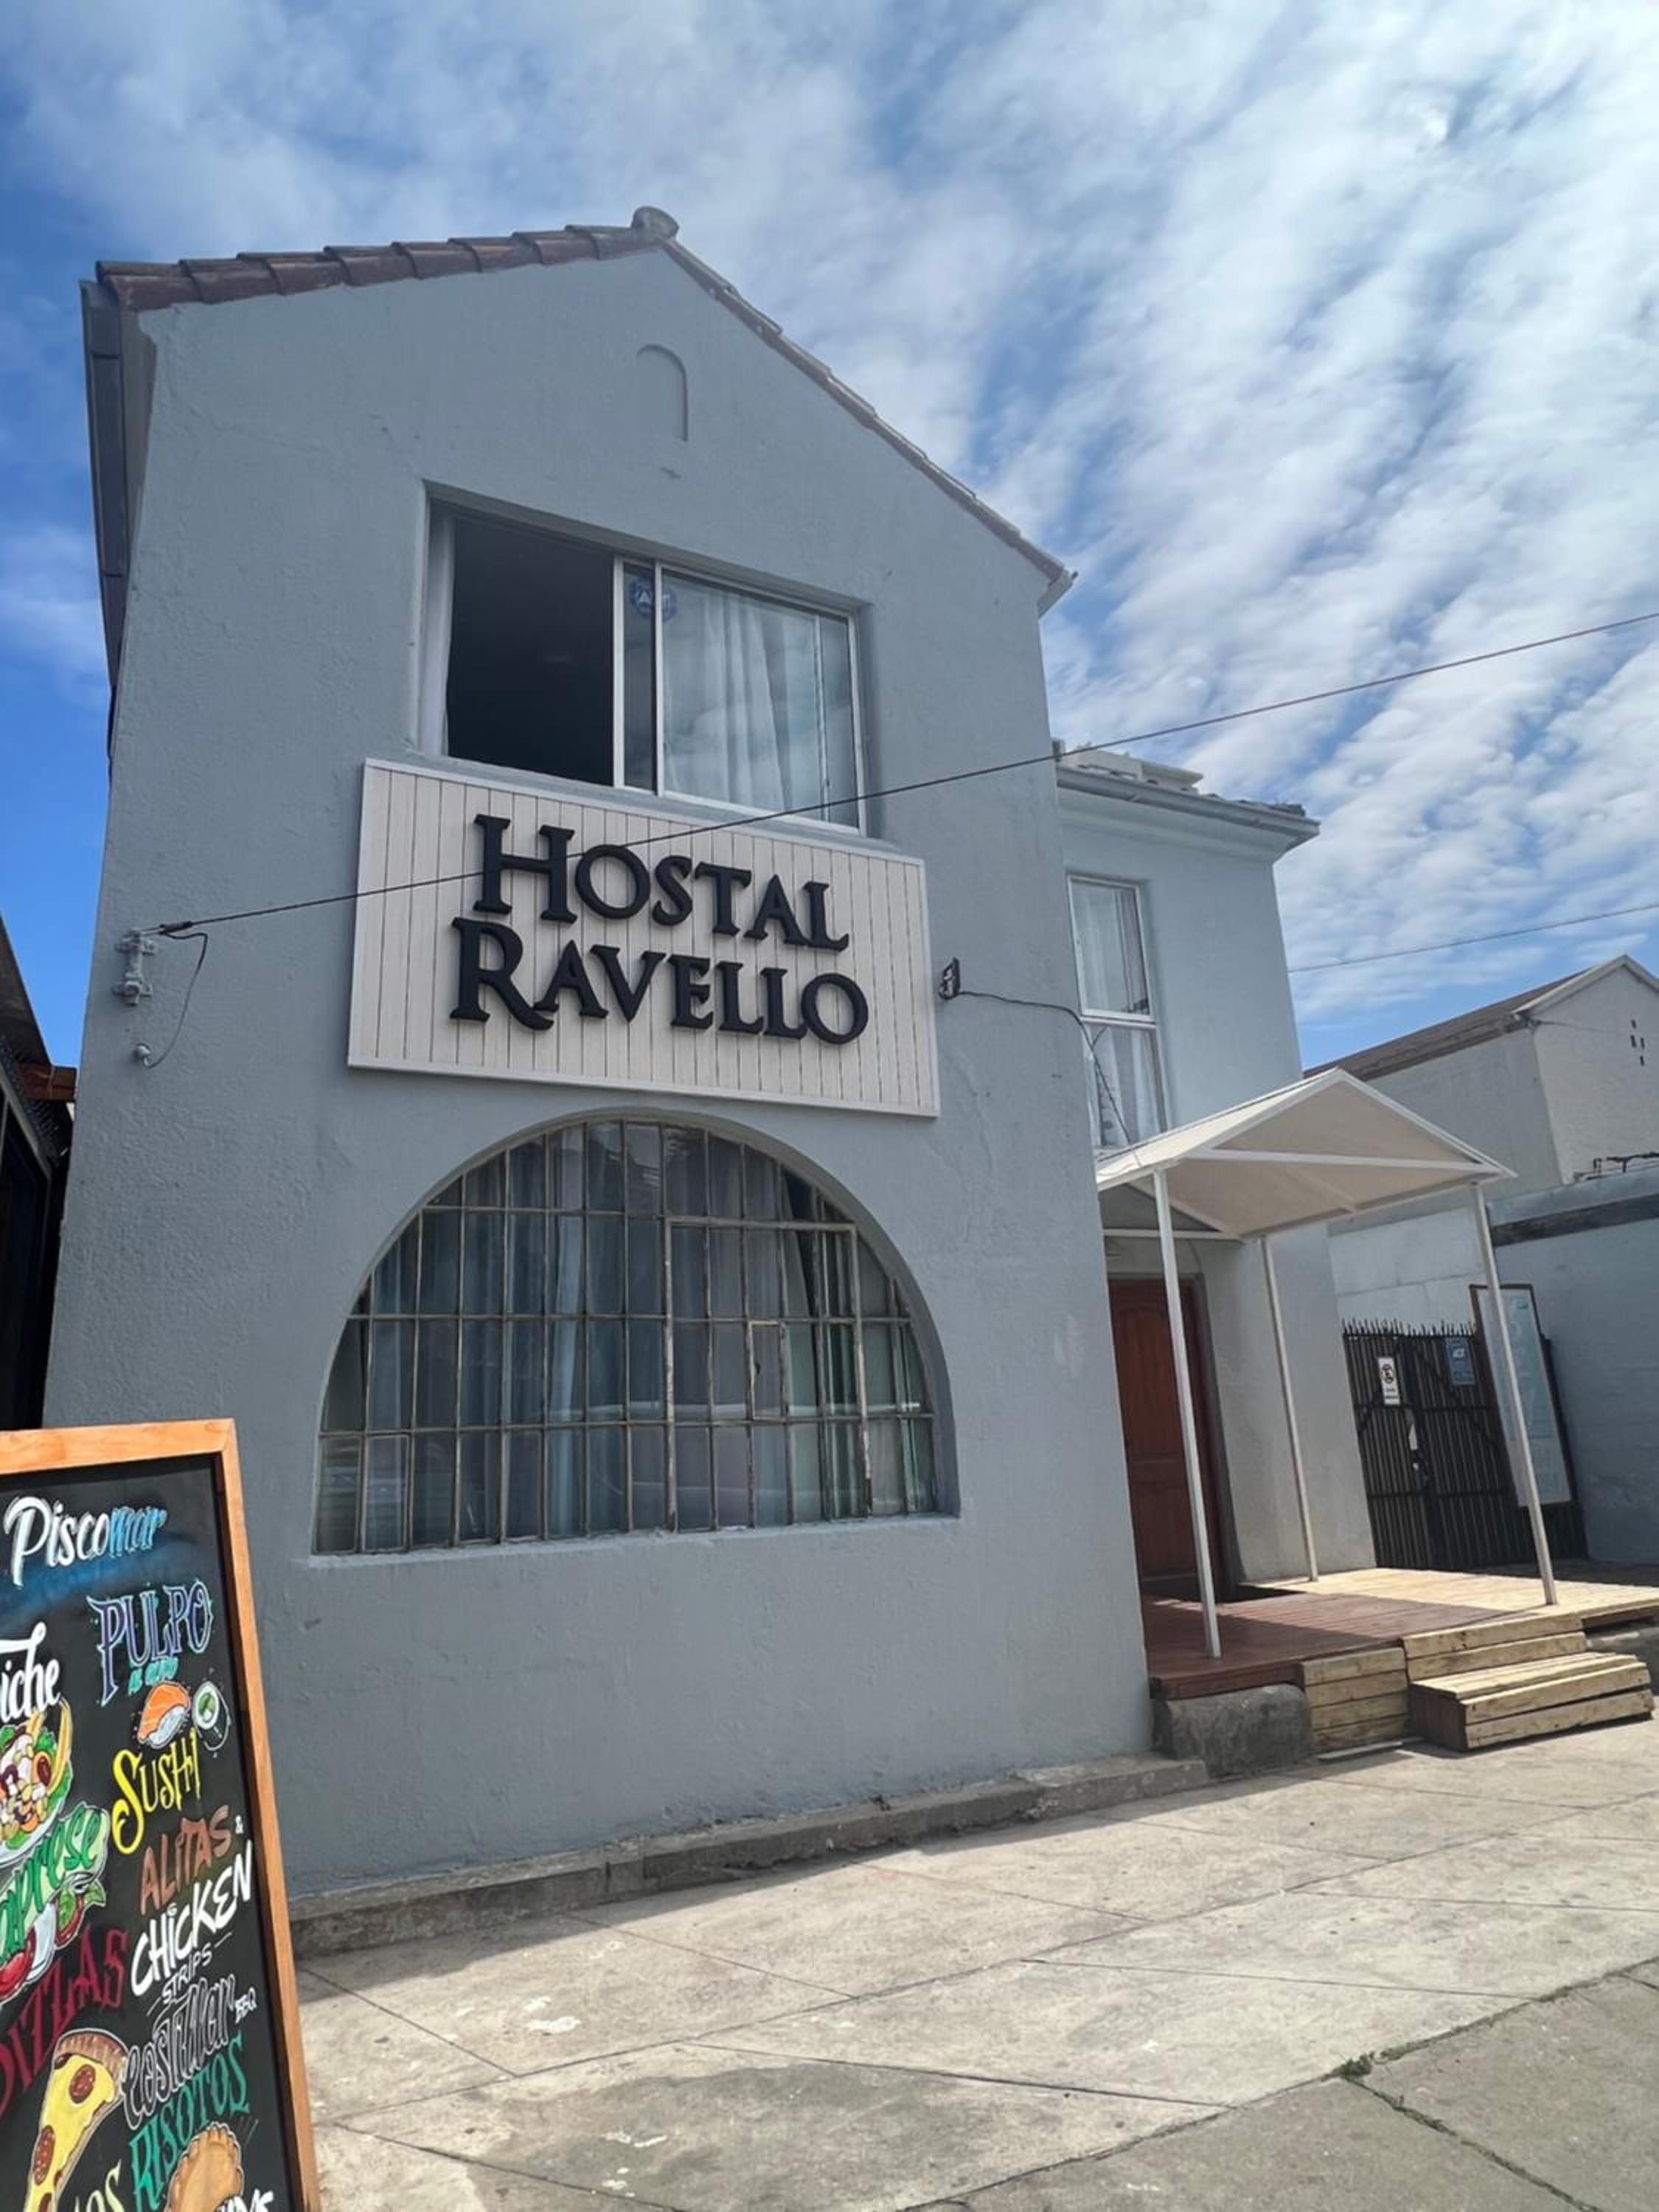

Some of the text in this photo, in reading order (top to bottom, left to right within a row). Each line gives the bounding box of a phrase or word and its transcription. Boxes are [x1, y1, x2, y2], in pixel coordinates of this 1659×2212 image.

[473, 814, 850, 952] HOSTAL
[449, 917, 869, 1045] RAVELLO
[3, 1496, 167, 1590] Piscomar
[86, 1579, 214, 1707] PULPO
[161, 1941, 213, 2004] STRIPS
